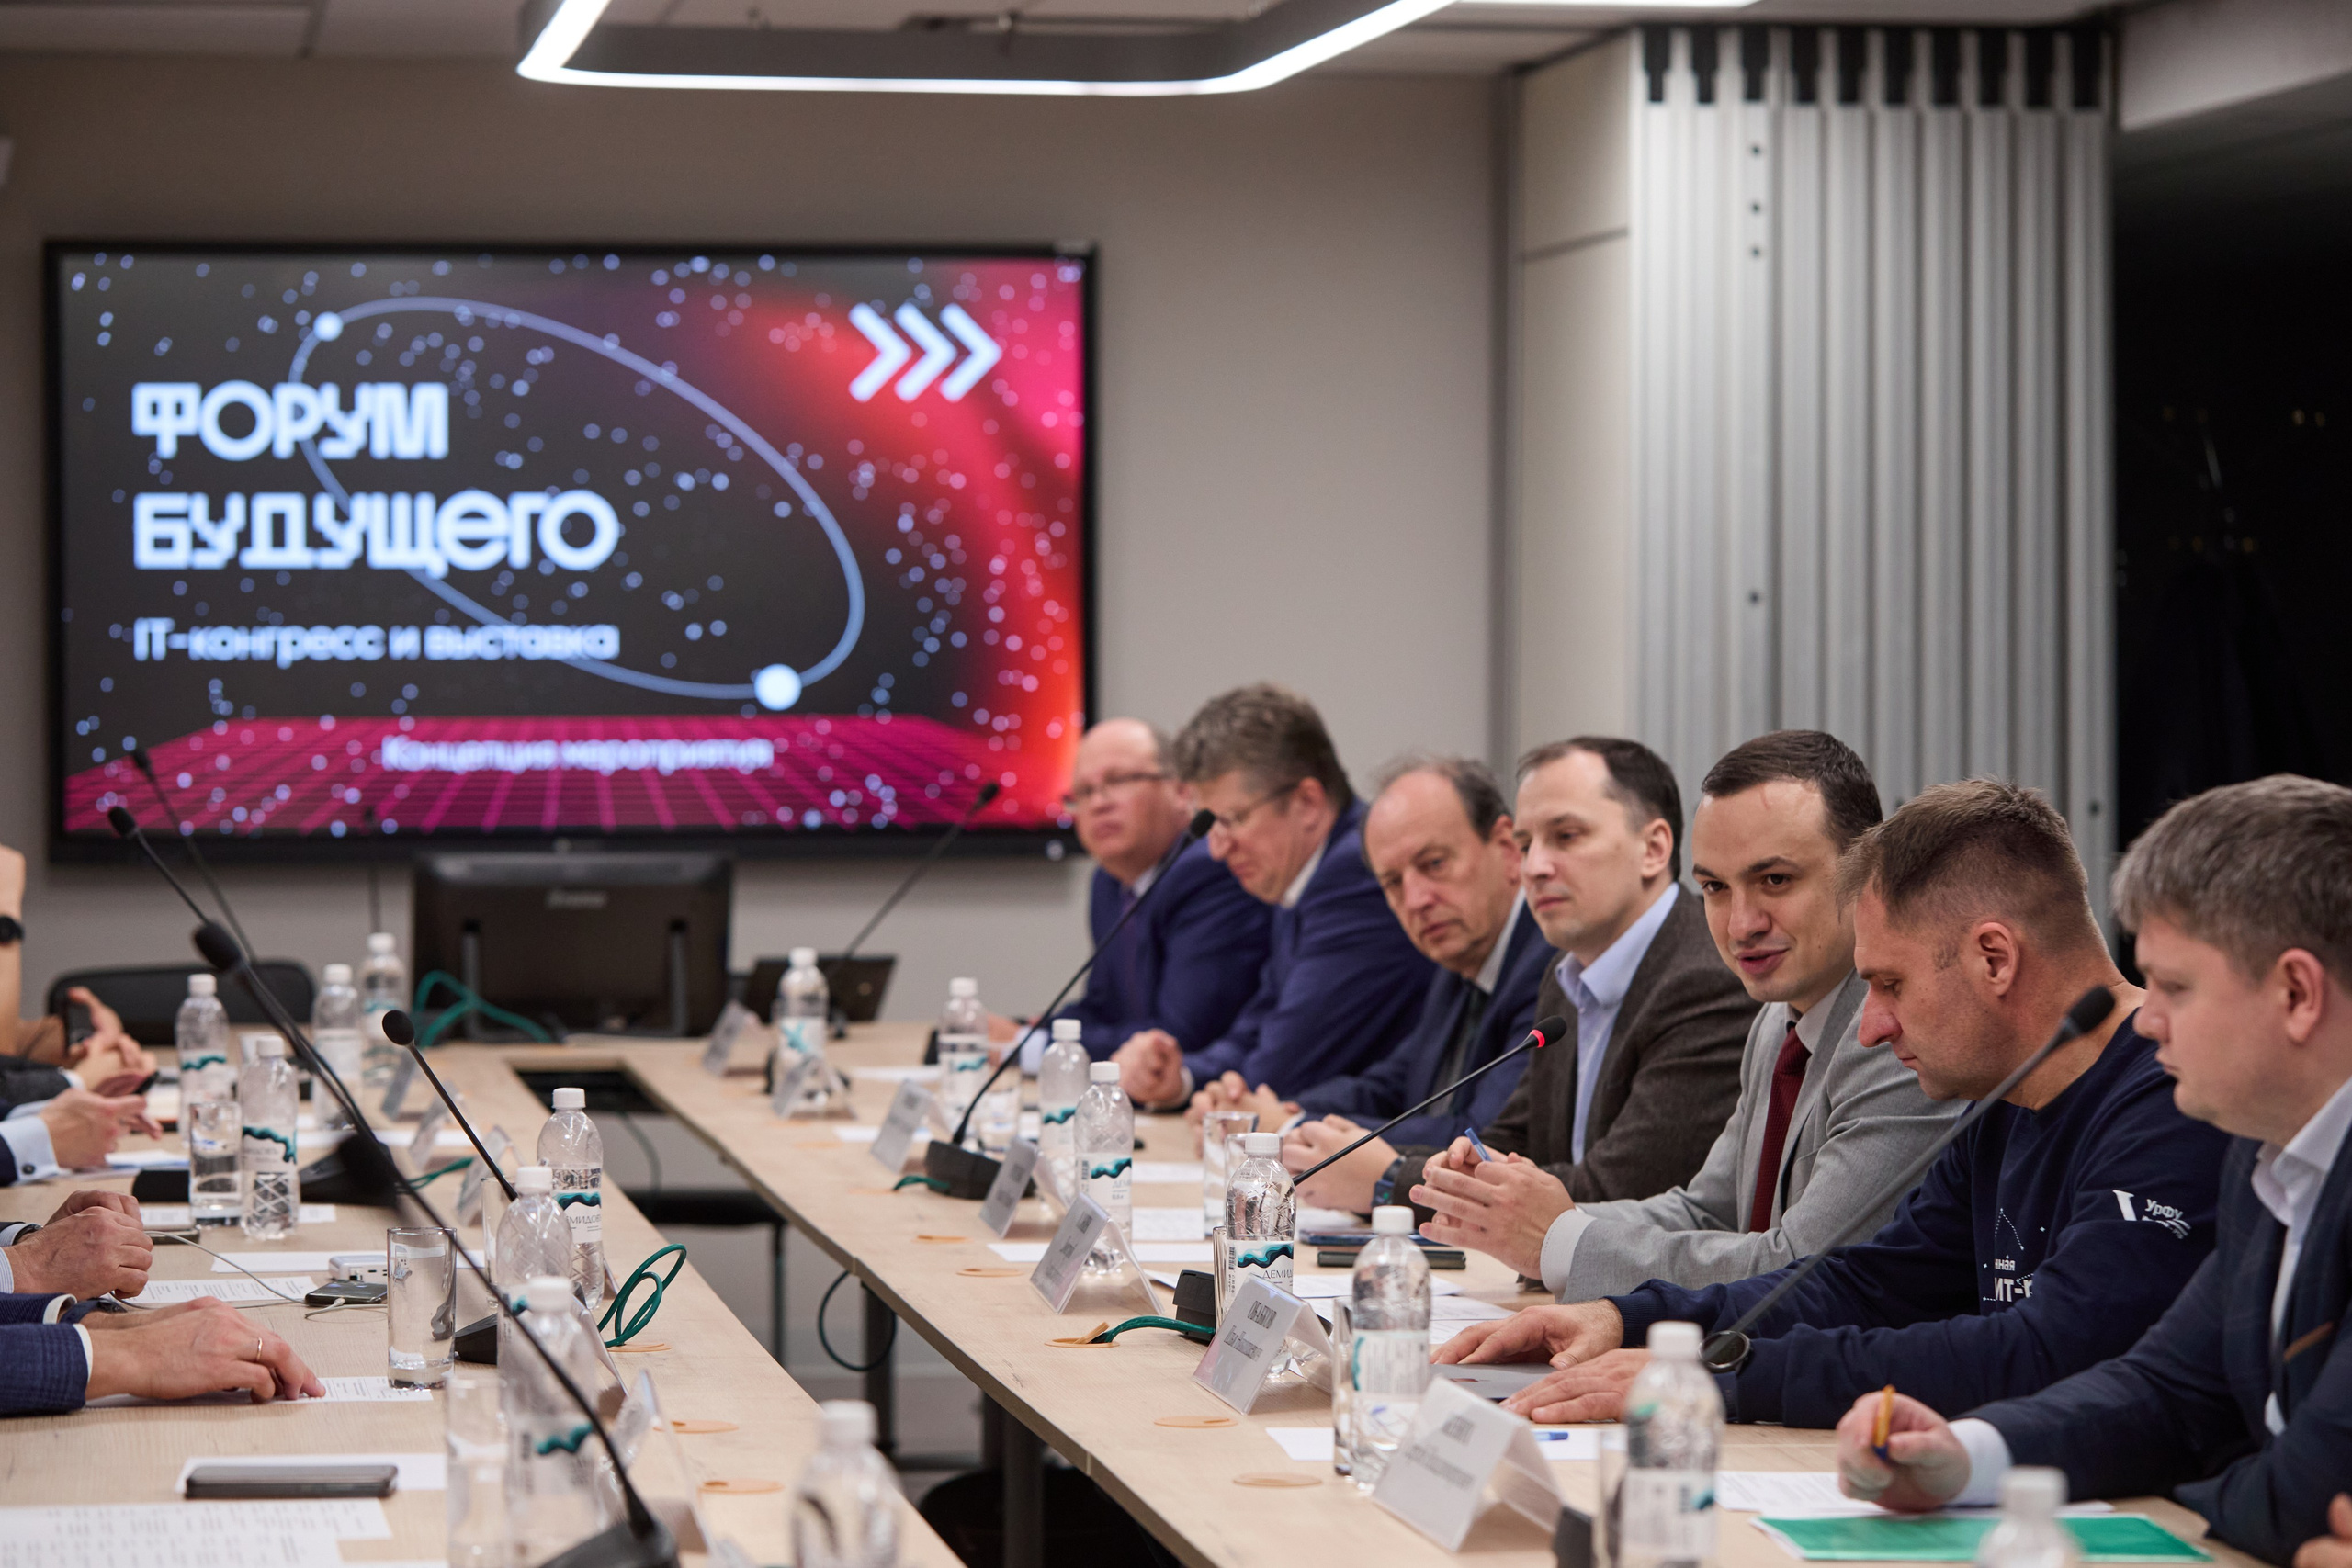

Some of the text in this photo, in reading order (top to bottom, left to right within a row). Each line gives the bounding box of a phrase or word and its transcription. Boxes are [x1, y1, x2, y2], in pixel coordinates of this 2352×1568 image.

[131, 379, 450, 461] ФОРУМ
[133, 616, 621, 669] IT-конгресс и выставка
[2144, 1198, 2184, 1220] УрФУ
